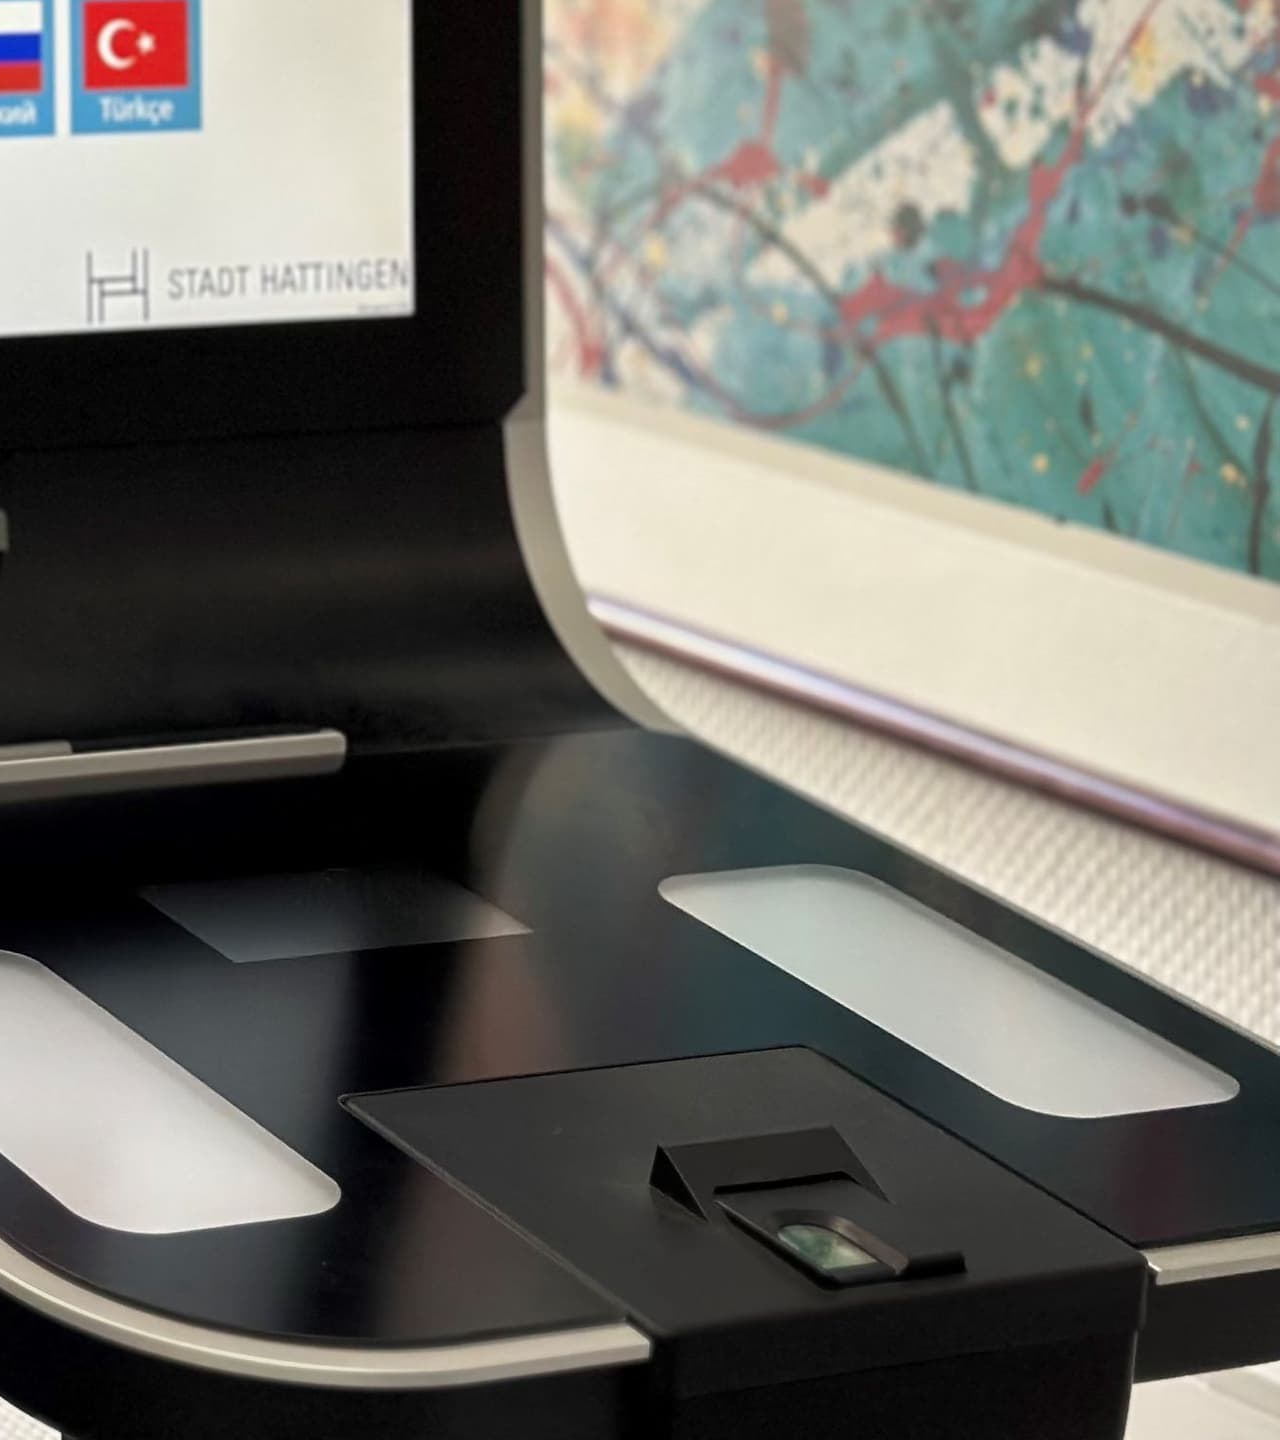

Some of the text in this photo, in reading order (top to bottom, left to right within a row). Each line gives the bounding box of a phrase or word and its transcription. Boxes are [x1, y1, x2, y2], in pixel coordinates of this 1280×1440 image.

[98, 96, 174, 124] Türkçe
[167, 257, 410, 300] STADT HATTINGEN
